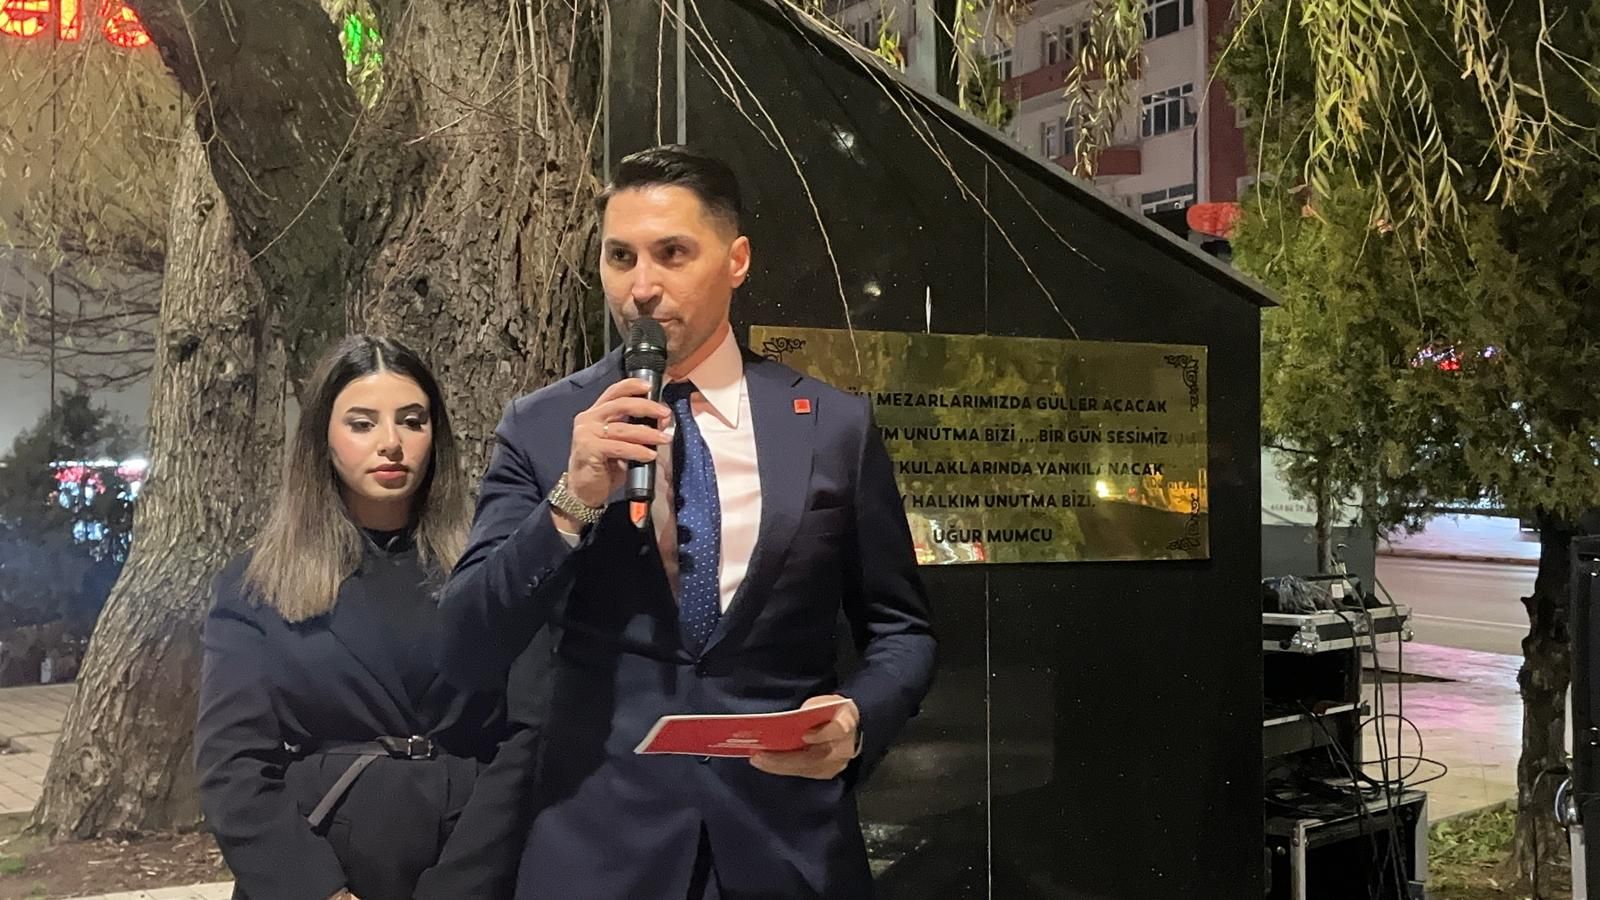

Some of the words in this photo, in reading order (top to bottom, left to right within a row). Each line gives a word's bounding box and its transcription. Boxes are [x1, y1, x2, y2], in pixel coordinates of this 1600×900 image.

[876, 392, 1032, 410] MEZARLARIMIZDA
[1036, 392, 1098, 411] GÜLLER
[1102, 399, 1168, 416] AÇACAK
[904, 427, 980, 442] UNUTMA
[985, 424, 1015, 442] BİZİ
[1039, 424, 1065, 443] BİR
[1068, 425, 1101, 443] GÜN
[1107, 426, 1169, 445] SESİMİZ
[900, 461, 1033, 475] KULAKLARINDA
[912, 494, 980, 508] HALKIM
[984, 494, 1057, 508] UNUTMA
[933, 524, 983, 544] UĞUR
[986, 528, 1053, 543] MUMCU
